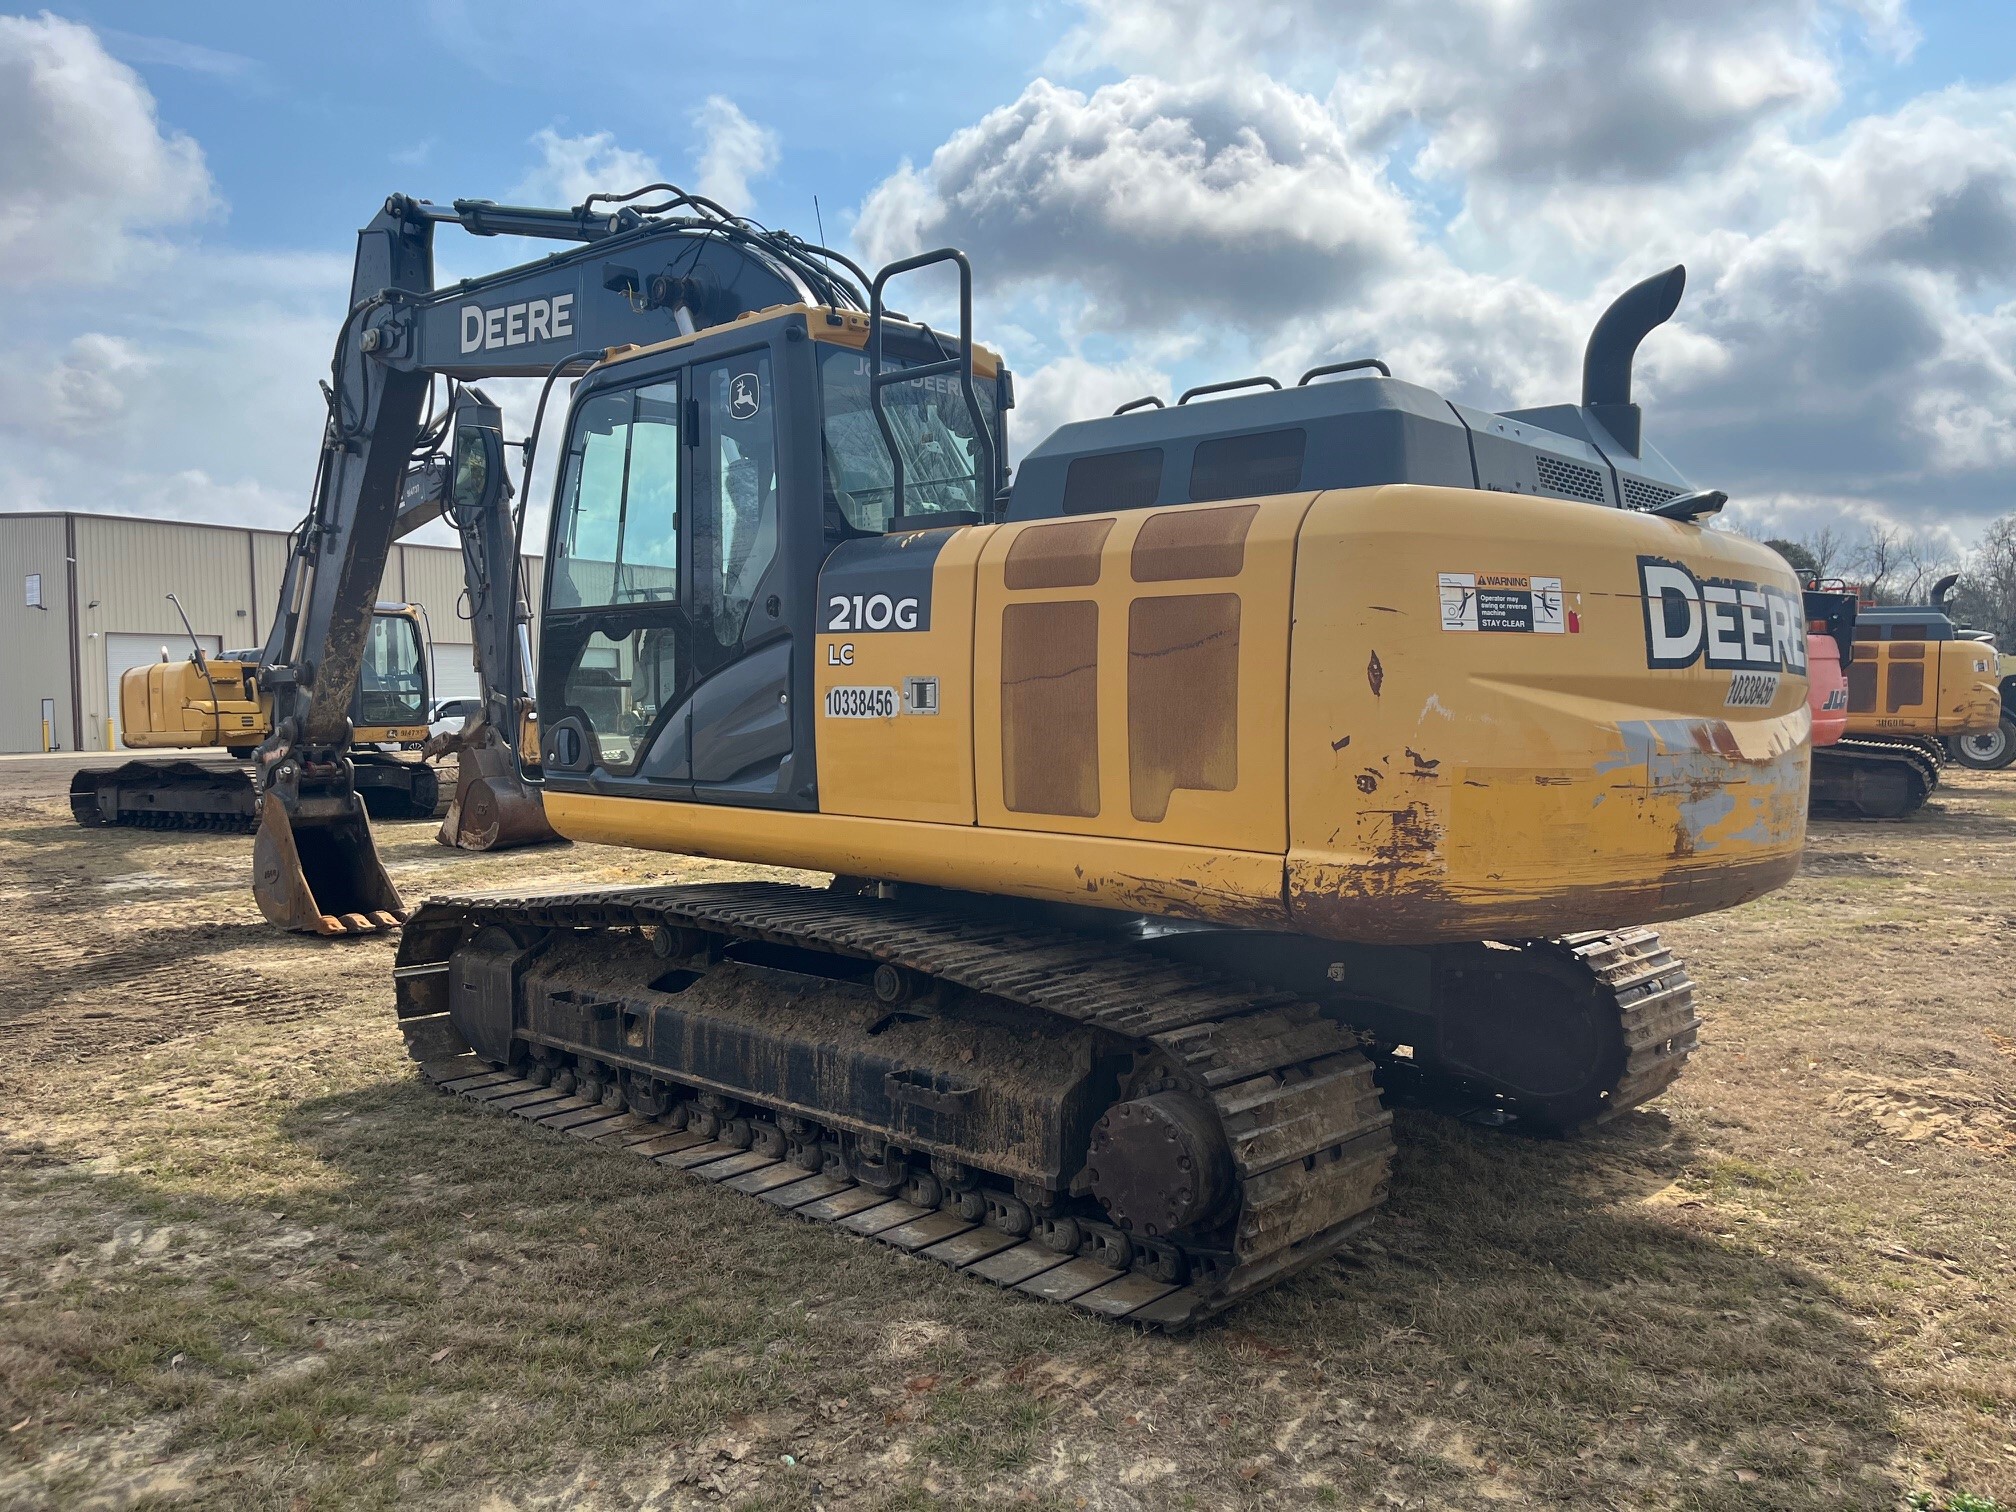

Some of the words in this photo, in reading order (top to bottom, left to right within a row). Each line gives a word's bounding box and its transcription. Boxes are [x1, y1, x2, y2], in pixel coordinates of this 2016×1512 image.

[461, 293, 574, 354] DEERE
[910, 375, 965, 398] DEER
[1486, 576, 1528, 587] WARNING
[1480, 594, 1505, 602] Operator
[1481, 602, 1499, 610] swing
[828, 594, 918, 630] 210G
[1481, 619, 1501, 627] STAY
[1501, 619, 1526, 628] CLEAR
[1643, 565, 1806, 668] DEERE
[828, 643, 854, 666] LC
[1726, 674, 1777, 705] 10338456
[1822, 690, 1847, 710] JLG
[826, 690, 893, 716] 10338456
